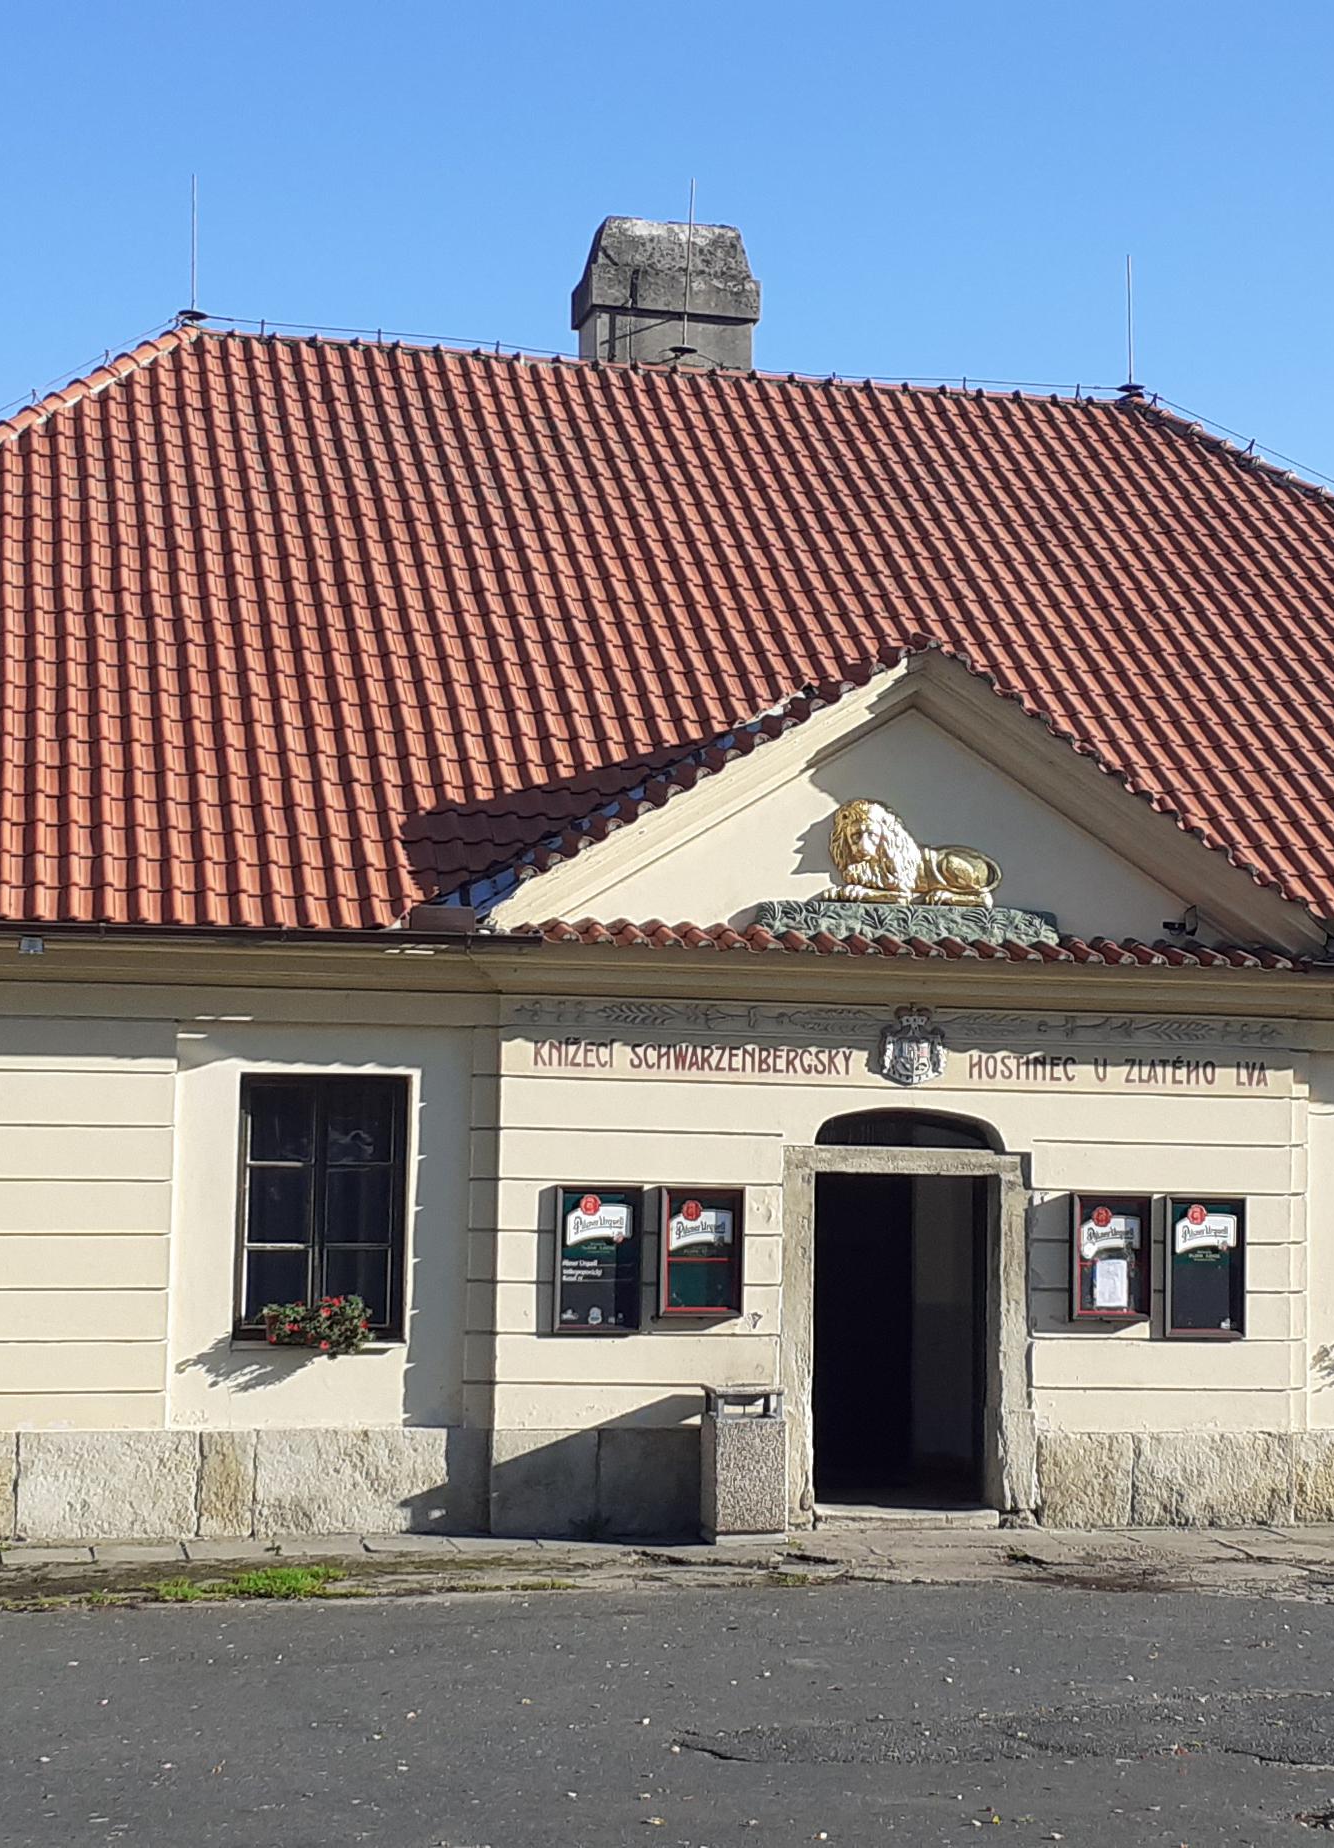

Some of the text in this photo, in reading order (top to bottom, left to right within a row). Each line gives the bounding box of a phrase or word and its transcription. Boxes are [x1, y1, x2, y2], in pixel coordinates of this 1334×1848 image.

[533, 1037, 1268, 1088] KNÍŽECÍ SCHWARZENBERGSKÝ HOSTINEC U ZLATÉHO LVA
[573, 1216, 624, 1235] Pilsner Urquell
[675, 1221, 726, 1240] Pilsner Urquell
[1087, 1227, 1134, 1243] Pilsner Urquell
[1181, 1225, 1229, 1243] Pilsner Urquell
